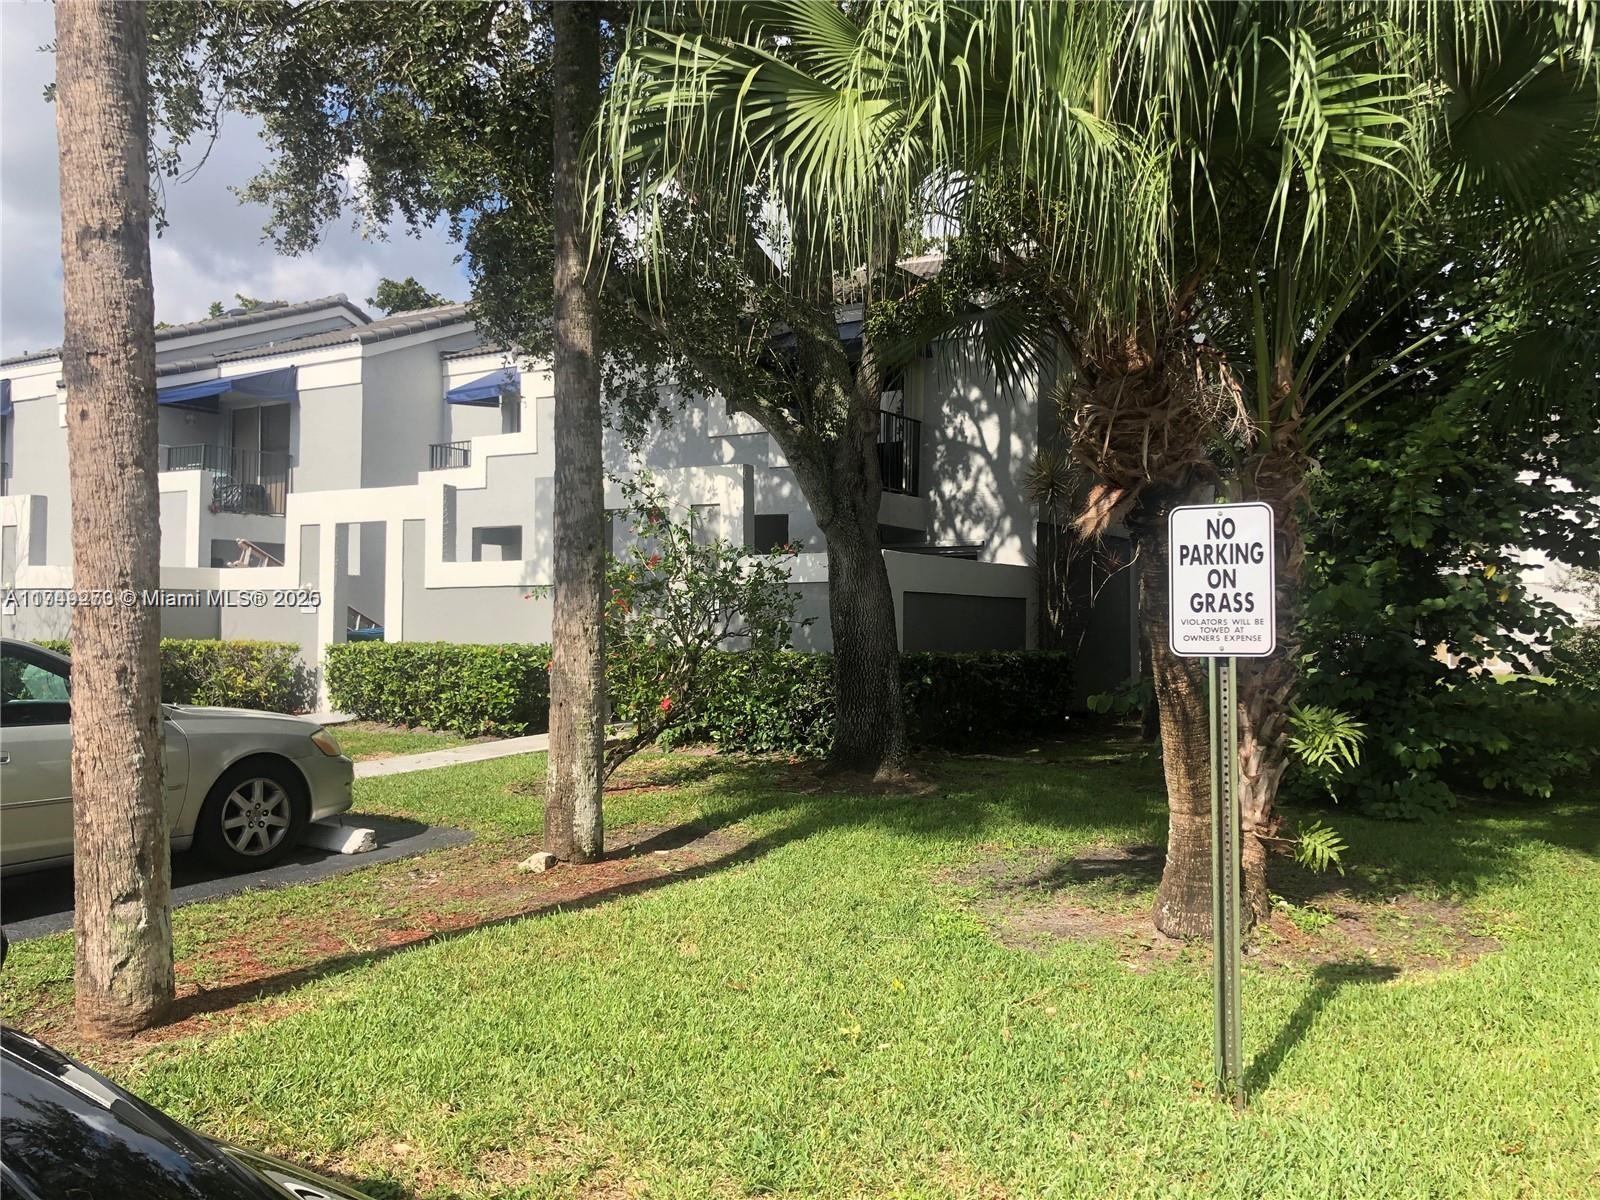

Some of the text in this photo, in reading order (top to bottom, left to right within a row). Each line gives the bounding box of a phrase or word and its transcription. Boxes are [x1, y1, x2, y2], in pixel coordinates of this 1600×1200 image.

[1206, 517, 1236, 540] NO
[1179, 541, 1264, 566] PARKING
[1207, 568, 1237, 589] ON
[1190, 592, 1255, 614] GRASS
[1181, 618, 1264, 626] VIOLATORS WILL BE
[1200, 626, 1245, 634] TOWED AT
[1183, 634, 1262, 642] OWNERS EXPENSE
